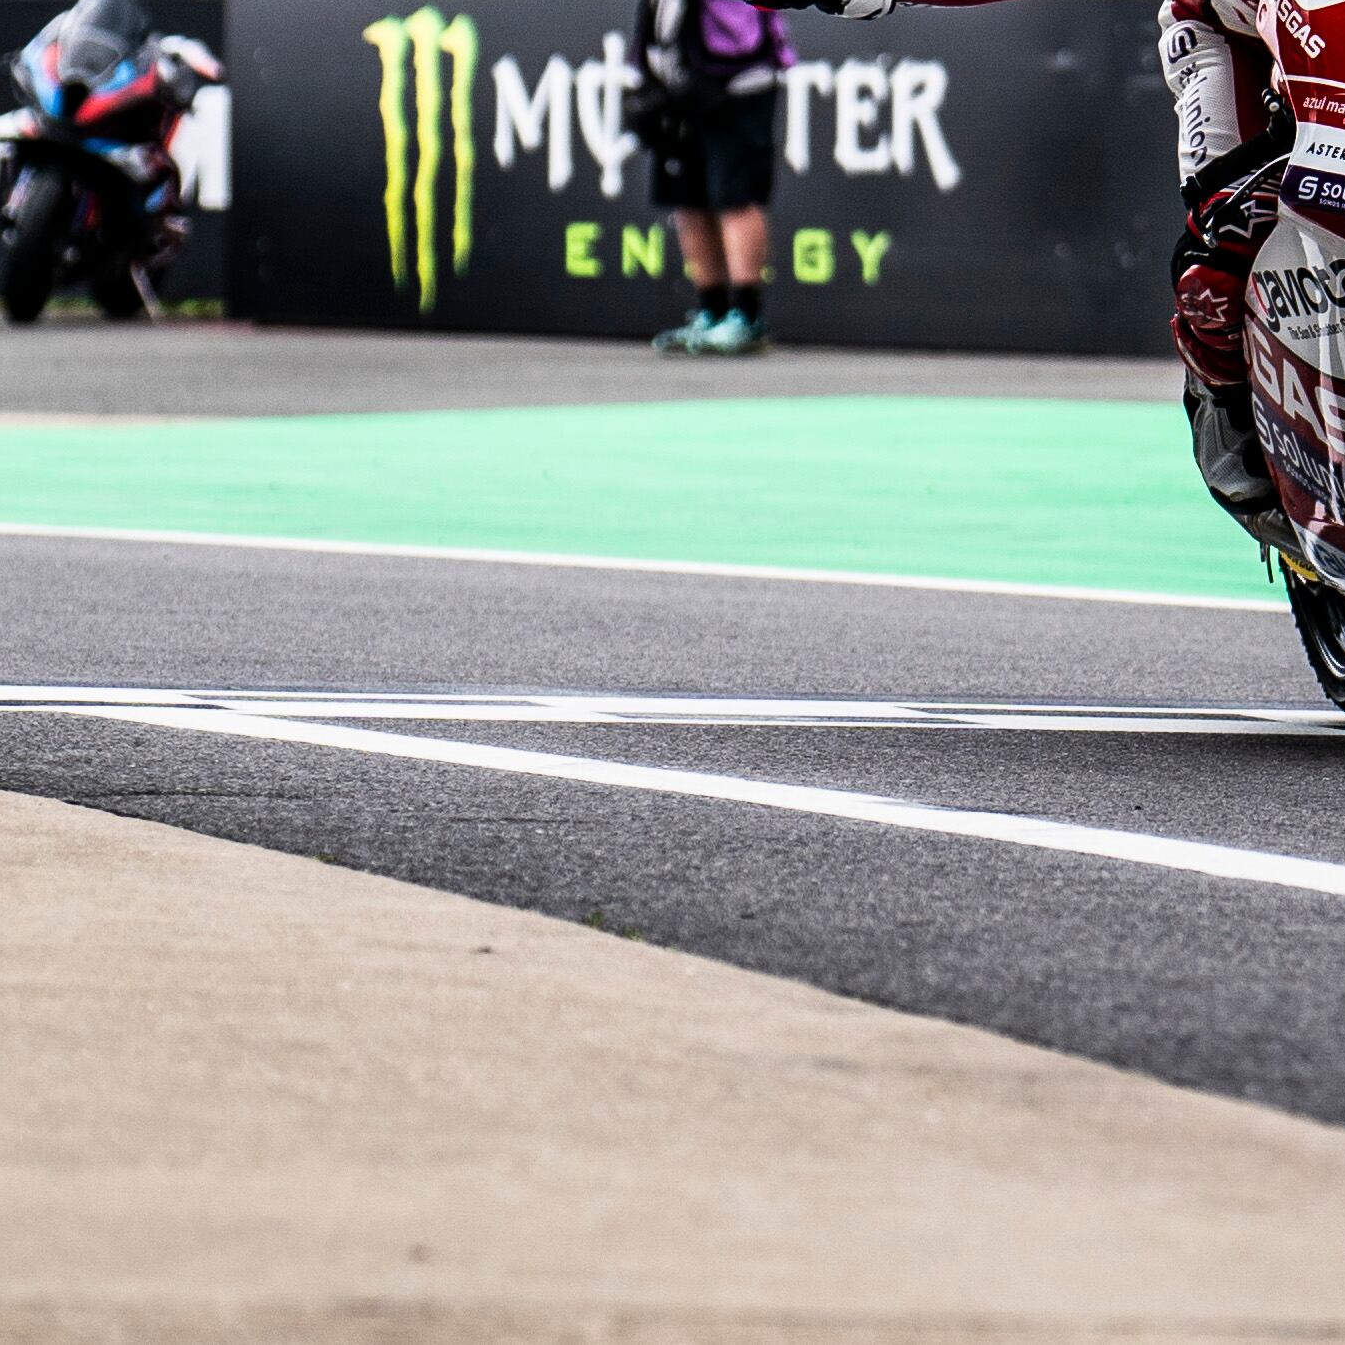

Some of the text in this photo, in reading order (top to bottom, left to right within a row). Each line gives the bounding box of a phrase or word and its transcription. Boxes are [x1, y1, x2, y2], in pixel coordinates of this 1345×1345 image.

[492, 31, 960, 198] MOTER
[1303, 96, 1327, 110] azul
[563, 220, 892, 284] ENGY
